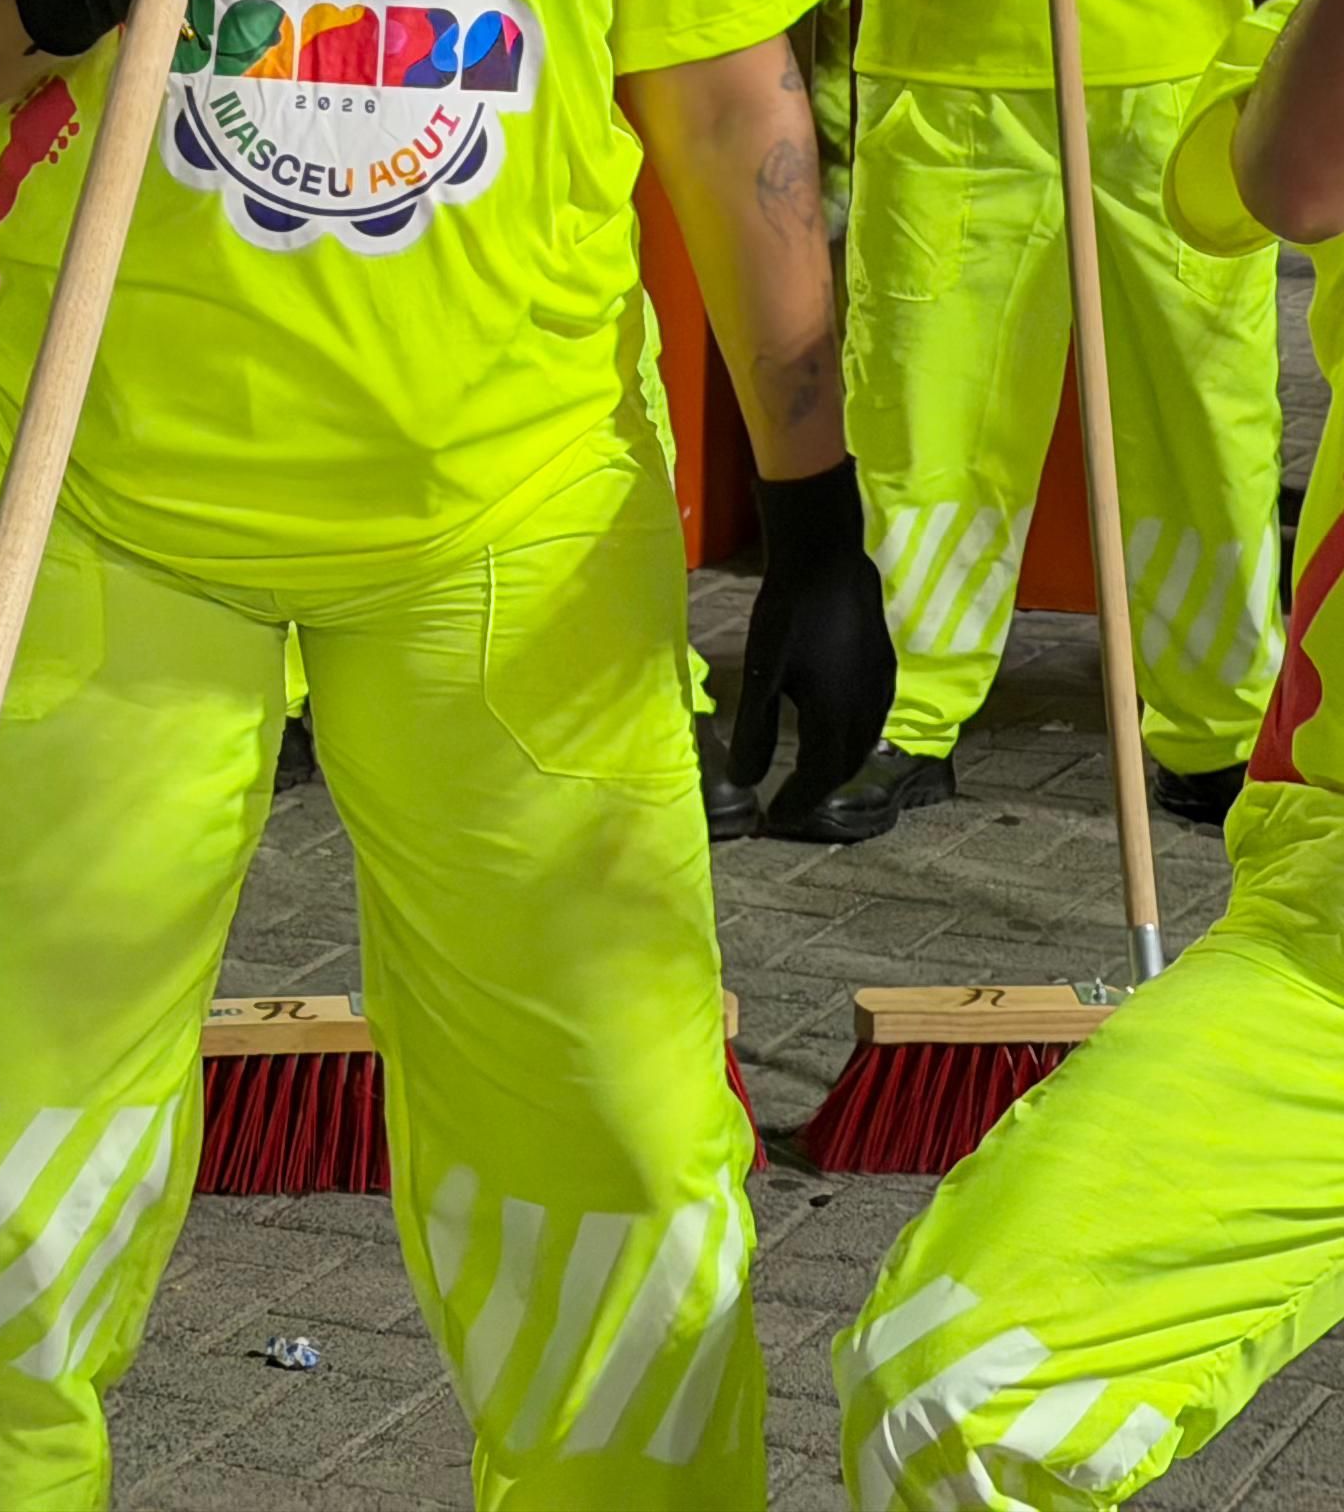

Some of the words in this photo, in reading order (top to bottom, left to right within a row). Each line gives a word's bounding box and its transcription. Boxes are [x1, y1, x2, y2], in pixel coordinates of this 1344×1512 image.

[295, 93, 376, 115] 2026
[208, 90, 355, 198] NASCEU
[368, 103, 462, 195] AQUI
